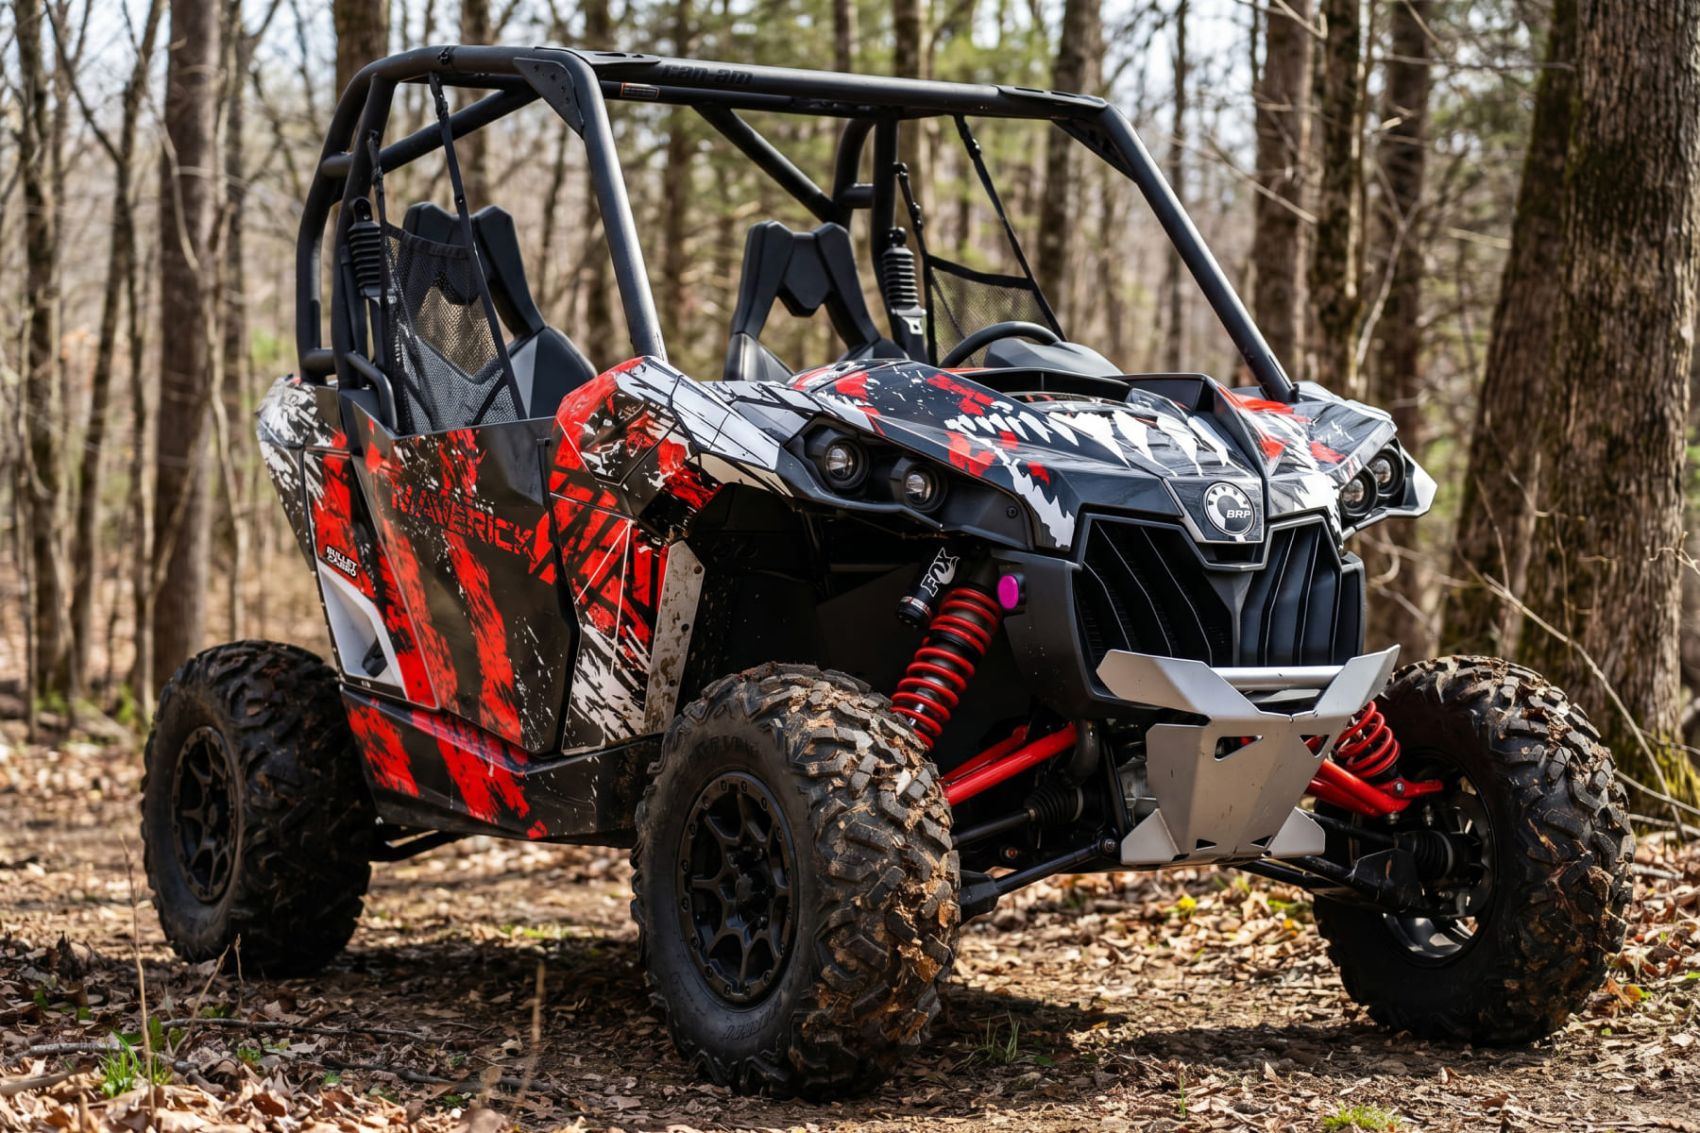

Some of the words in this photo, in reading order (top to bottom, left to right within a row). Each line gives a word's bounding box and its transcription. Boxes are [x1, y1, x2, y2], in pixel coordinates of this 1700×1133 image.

[391, 484, 535, 562] MAVERICK
[1226, 509, 1251, 519] BRP
[326, 546, 357, 570] BULLET
[920, 547, 960, 597] FOX
